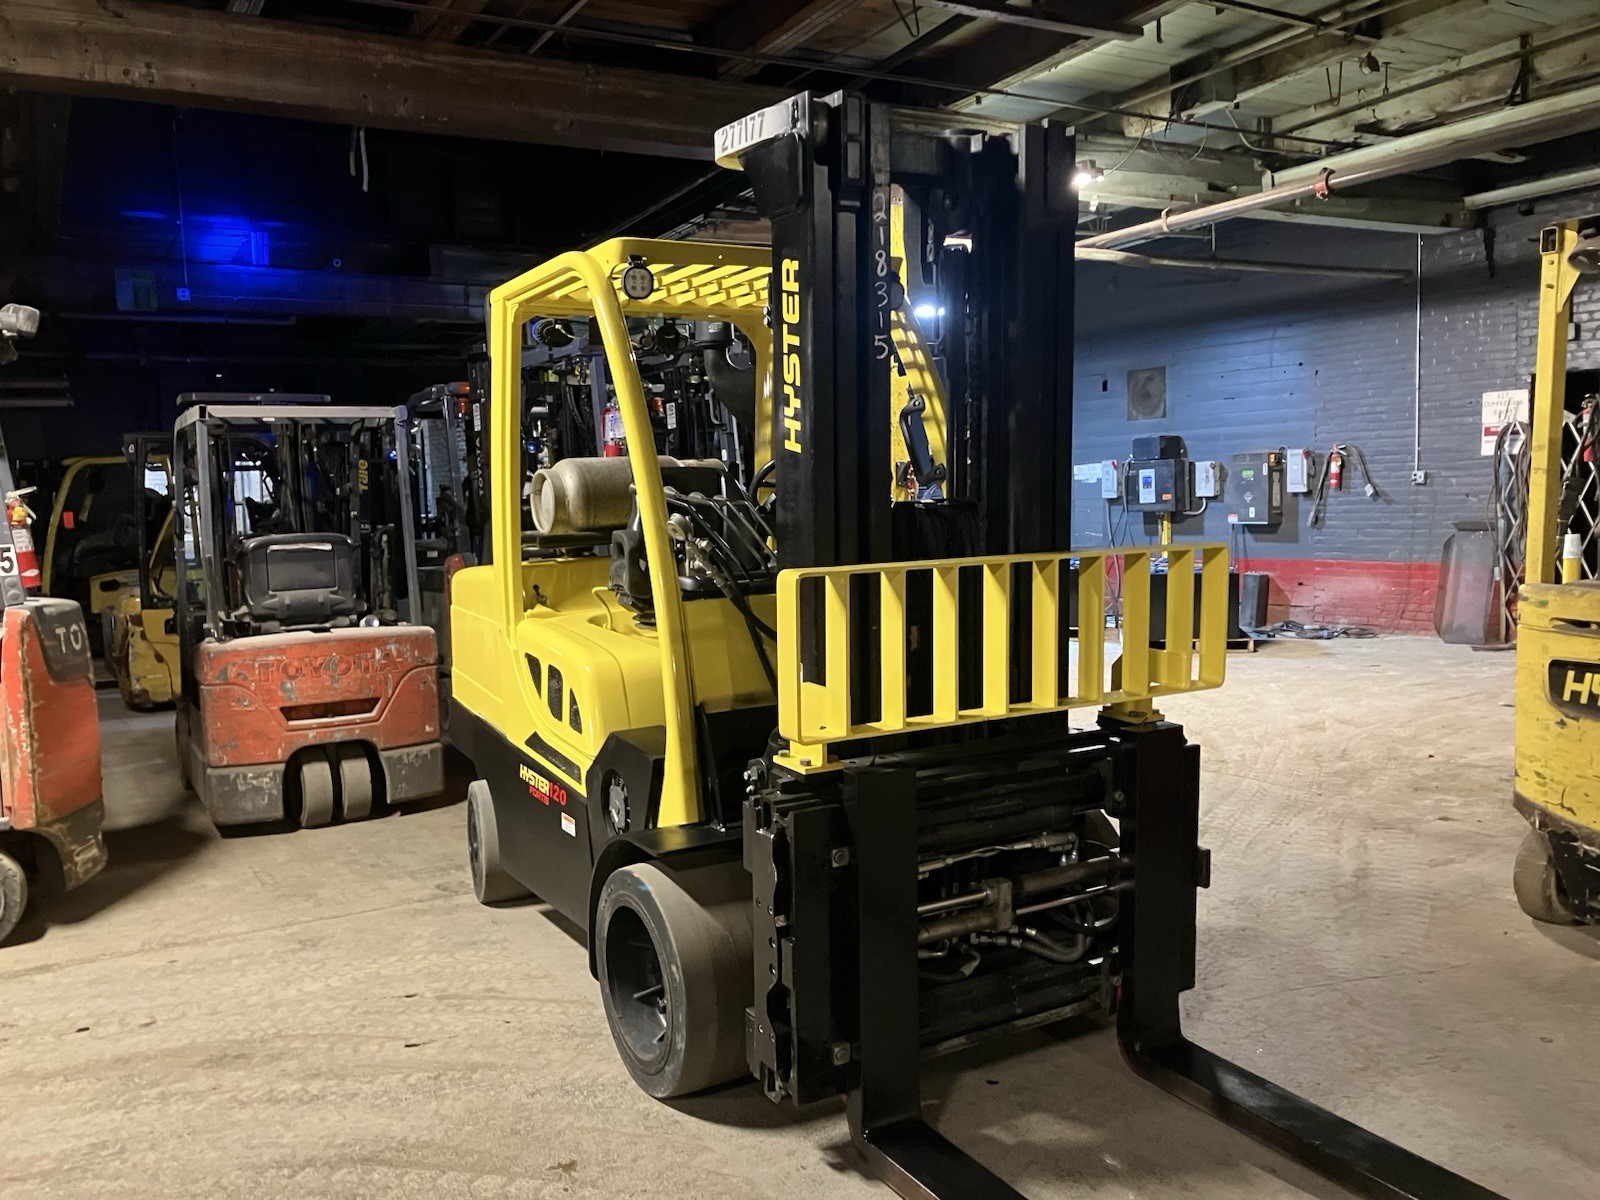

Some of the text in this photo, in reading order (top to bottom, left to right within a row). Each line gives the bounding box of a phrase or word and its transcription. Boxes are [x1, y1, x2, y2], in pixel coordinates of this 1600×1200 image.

[782, 258, 802, 454] HYSTER
[254, 650, 400, 683] TOYOTA
[520, 763, 567, 806] HYSTER 120
